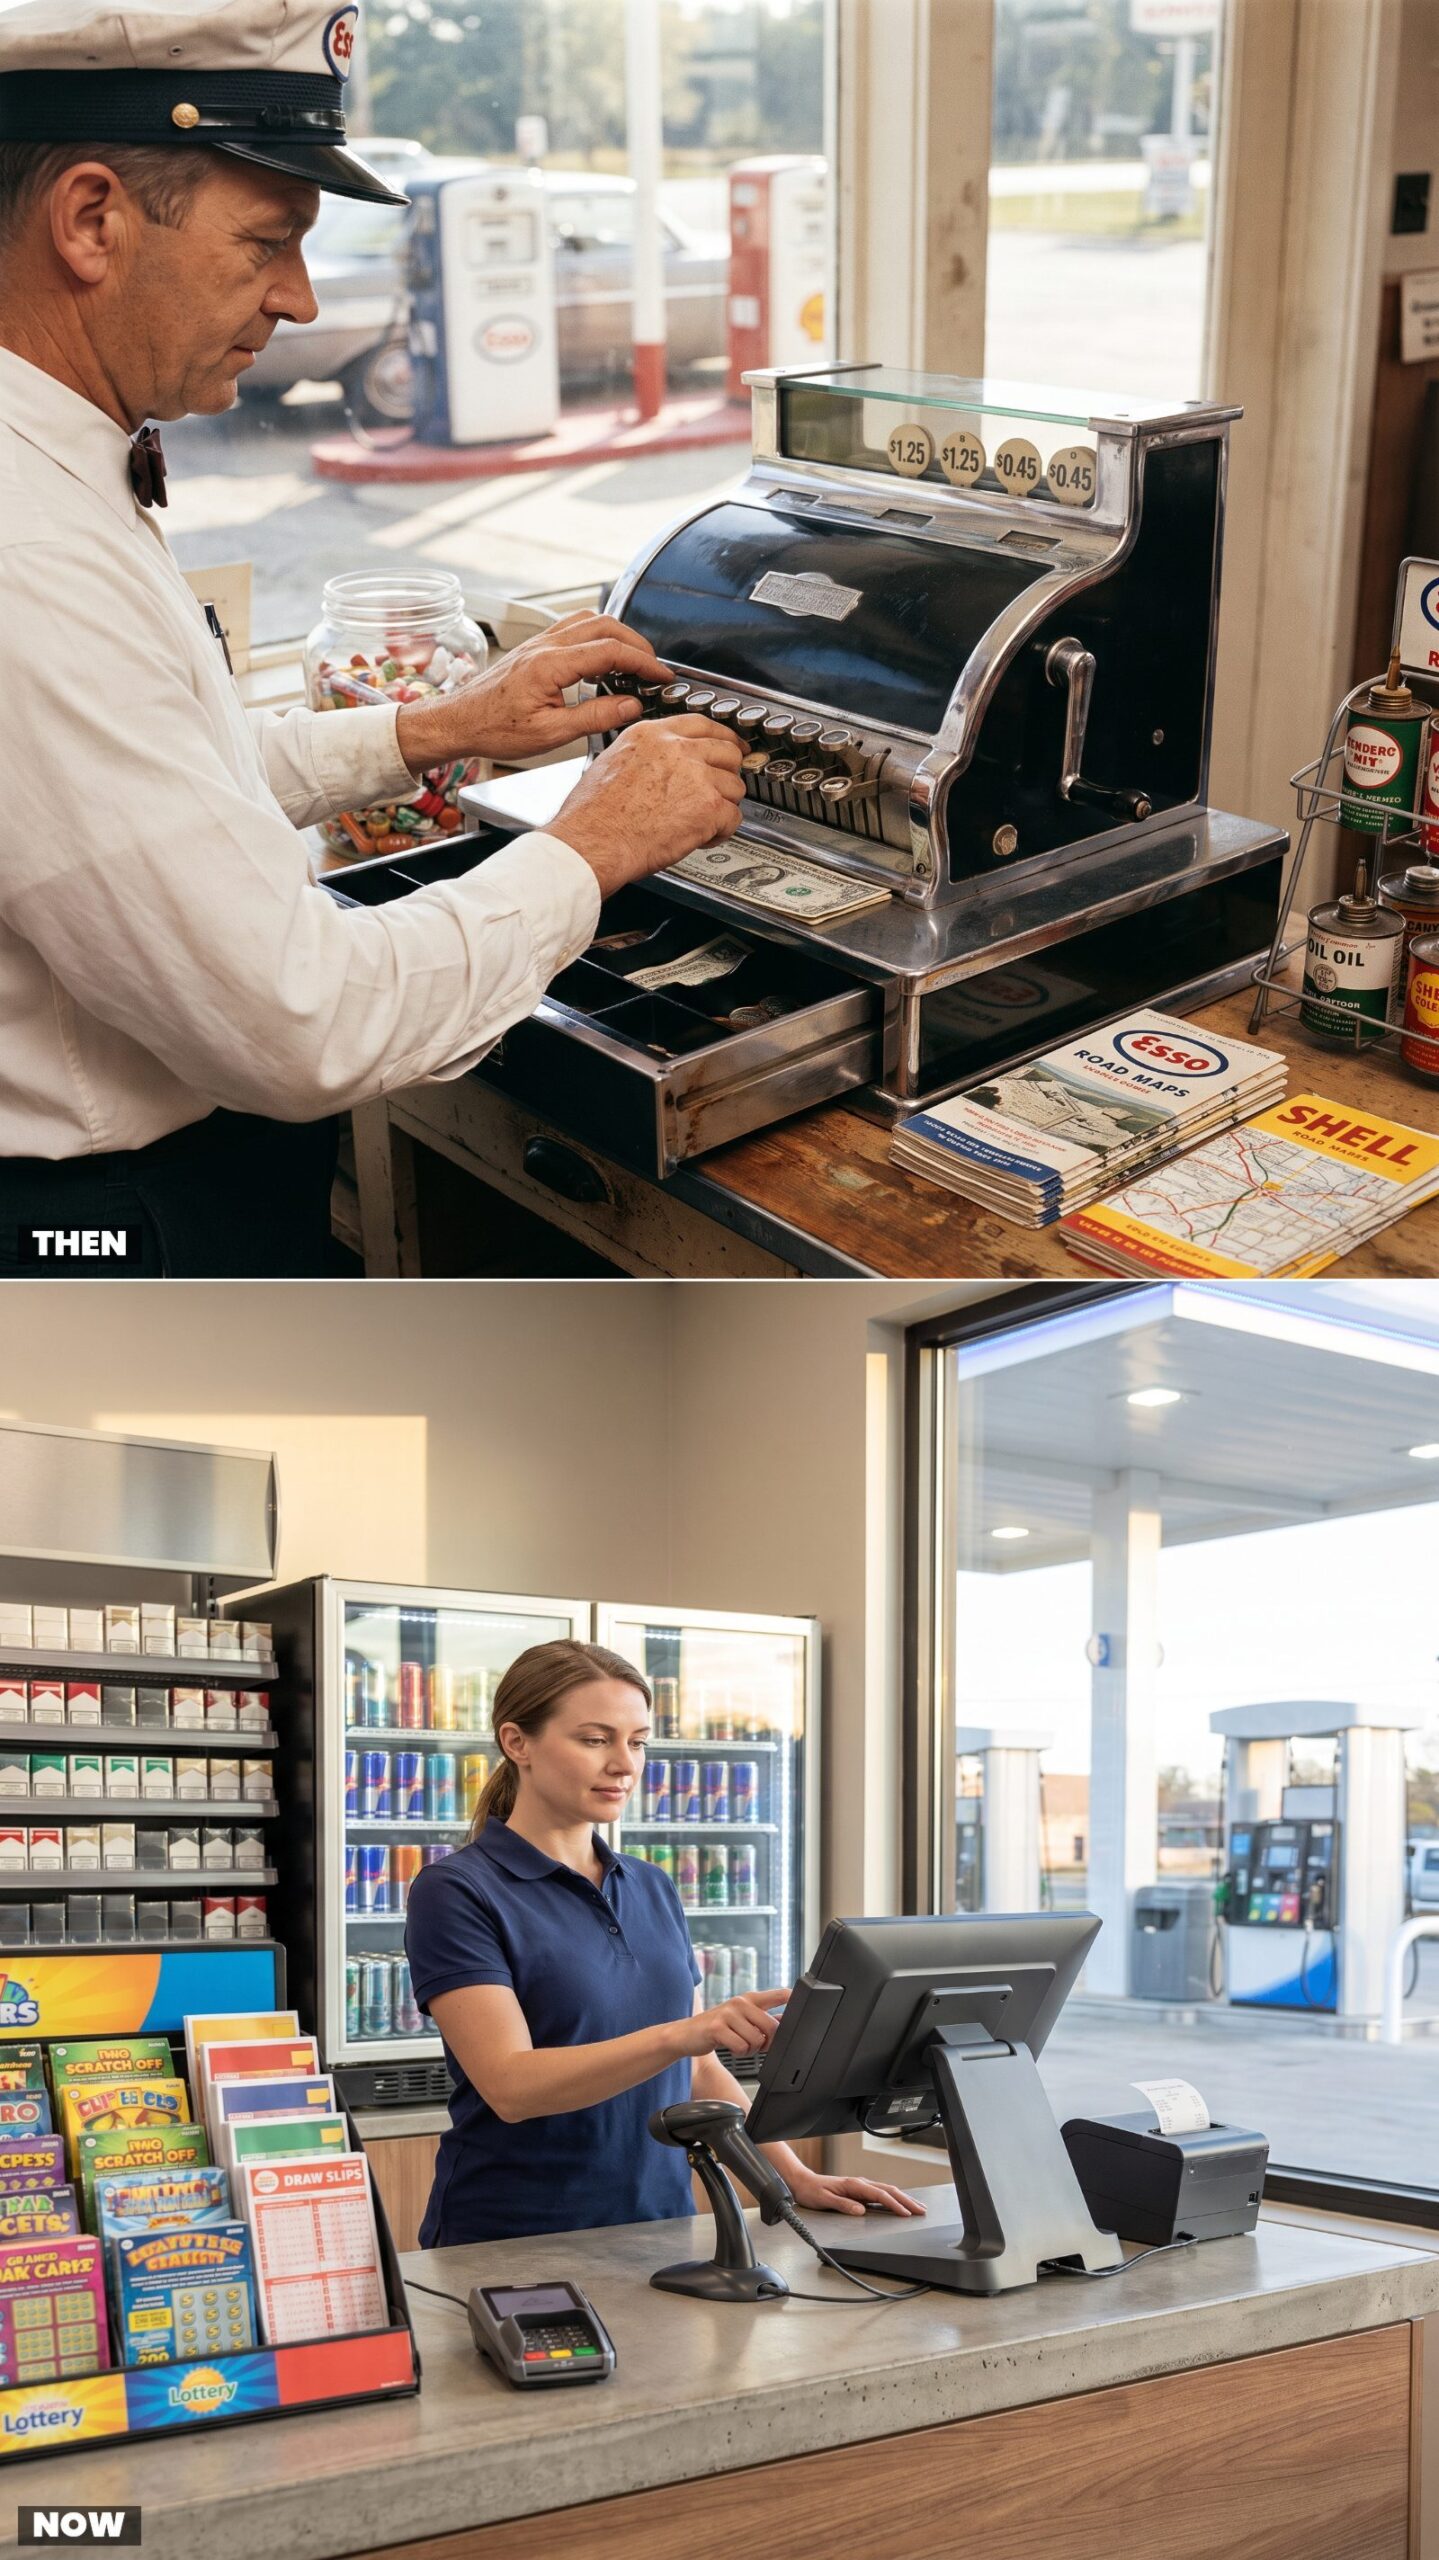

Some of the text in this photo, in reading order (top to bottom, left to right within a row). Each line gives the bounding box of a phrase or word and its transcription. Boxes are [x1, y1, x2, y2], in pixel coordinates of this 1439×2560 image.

[890, 440, 925, 465] $1.25
[942, 446, 979, 473] $1.25
[997, 453, 1037, 480] $0.45
[1050, 463, 1092, 491] $0.45
[1333, 948, 1365, 967] OIL
[1073, 1050, 1129, 1075] ROAD
[1132, 1074, 1190, 1097] MAPS
[1276, 1105, 1419, 1167] SHELL
[1292, 1131, 1325, 1146] ROAD
[65, 2058, 163, 2075] SCRATCH OFF
[94, 2148, 197, 2170] SCRATCH OFF
[284, 2172, 323, 2187] DRAW
[326, 2168, 362, 2182] SLIPS
[170, 2382, 237, 2405] Lottery
[5, 2407, 84, 2433] Lottery
